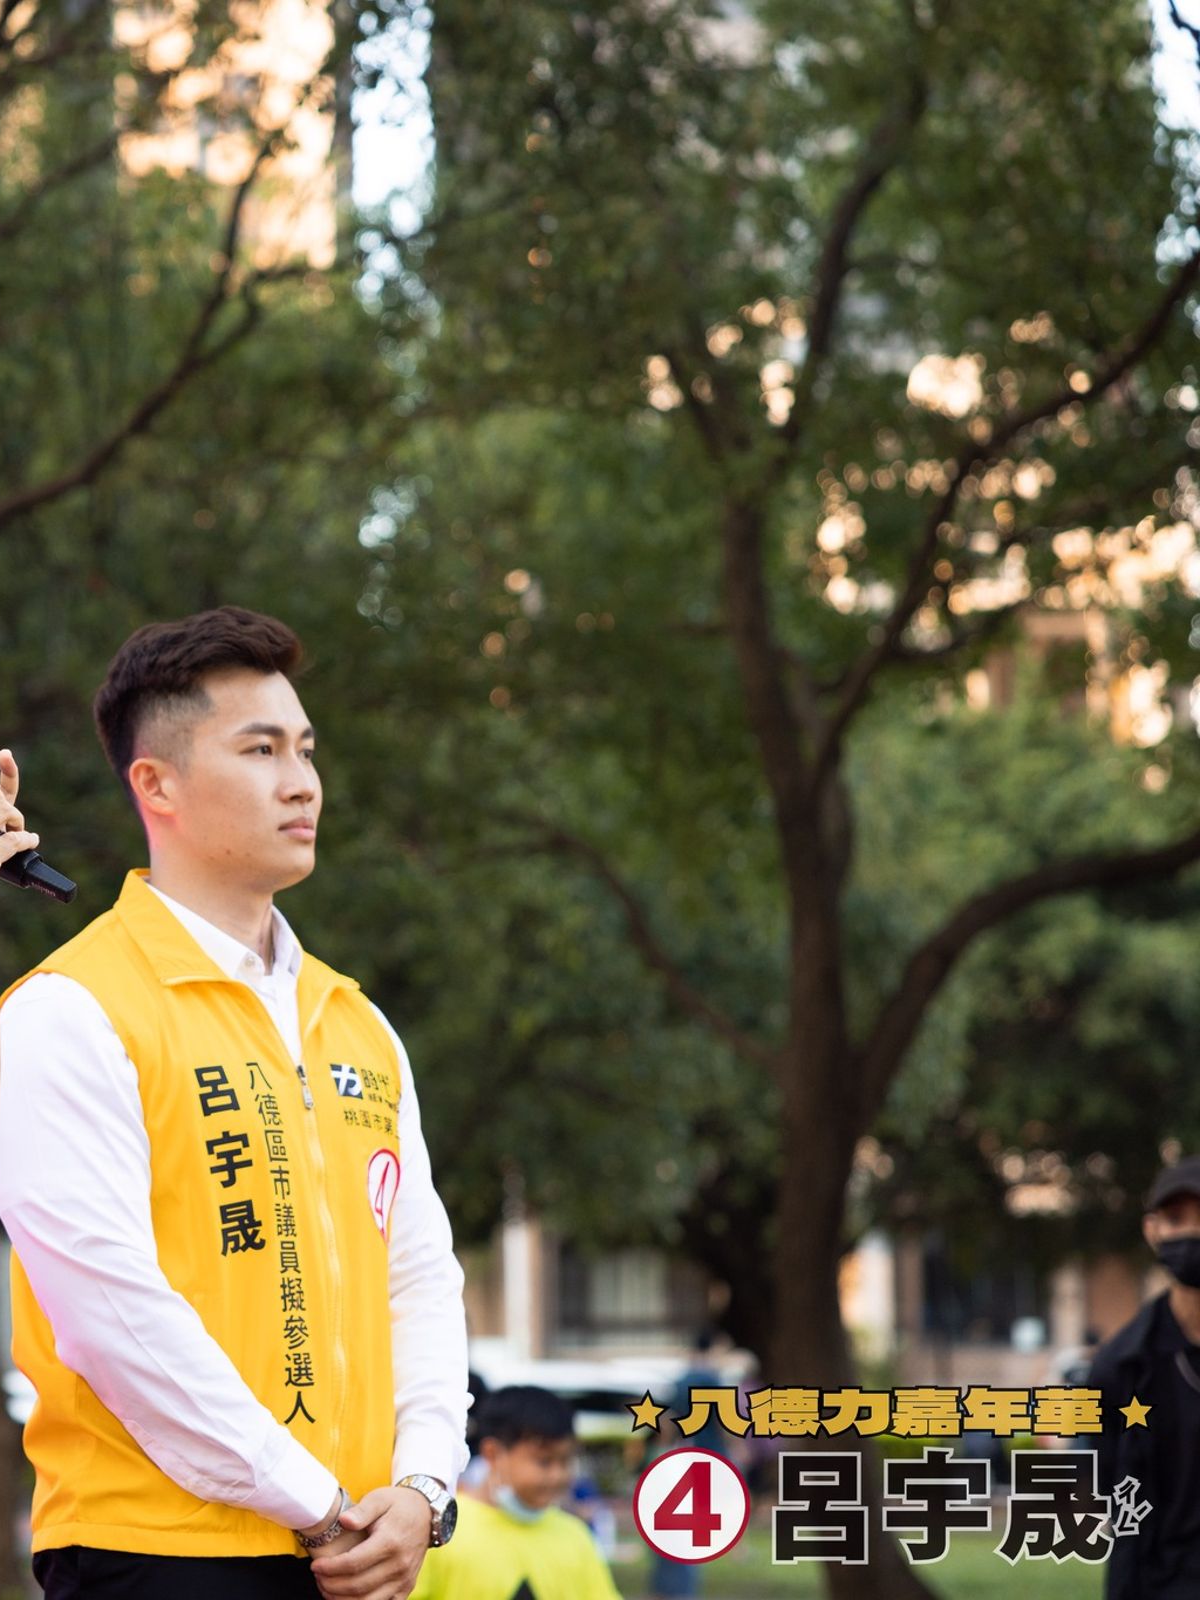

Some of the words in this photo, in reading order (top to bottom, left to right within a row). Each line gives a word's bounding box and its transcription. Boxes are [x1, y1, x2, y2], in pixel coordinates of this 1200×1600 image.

[194, 1064, 266, 1257] 呂宇晟
[343, 1107, 400, 1140] 桃園市第
[246, 1061, 316, 1425] 八德區市議員擬參選人
